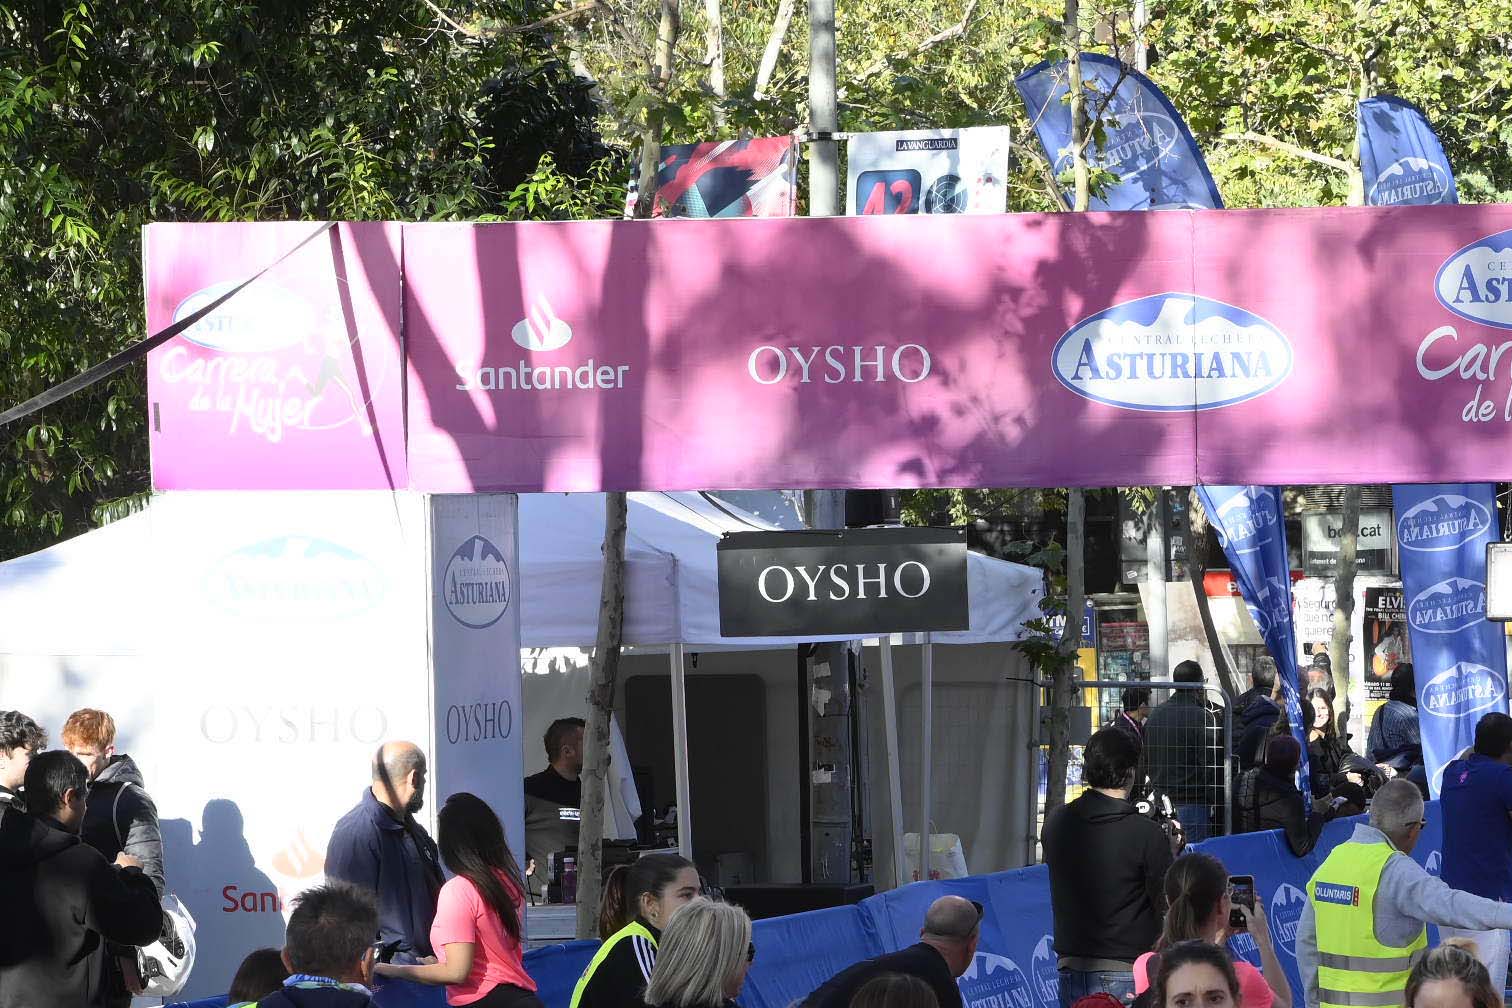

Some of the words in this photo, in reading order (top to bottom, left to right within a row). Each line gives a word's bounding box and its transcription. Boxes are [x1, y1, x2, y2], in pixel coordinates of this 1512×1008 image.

[907, 139, 957, 150] VANGUARDIA
[160, 346, 278, 385] Carrera
[456, 360, 629, 391] Santander
[748, 343, 931, 385] OYSHO
[1071, 341, 1273, 383] ASTURIANA
[229, 382, 324, 443] Mujer
[1462, 388, 1496, 423] de
[450, 570, 507, 606] ASTURIANA
[756, 560, 931, 603] OYSHO
[1378, 596, 1406, 609] ELVI
[446, 700, 513, 745] OYSHO
[1315, 886, 1352, 901] OLUNTARIS
